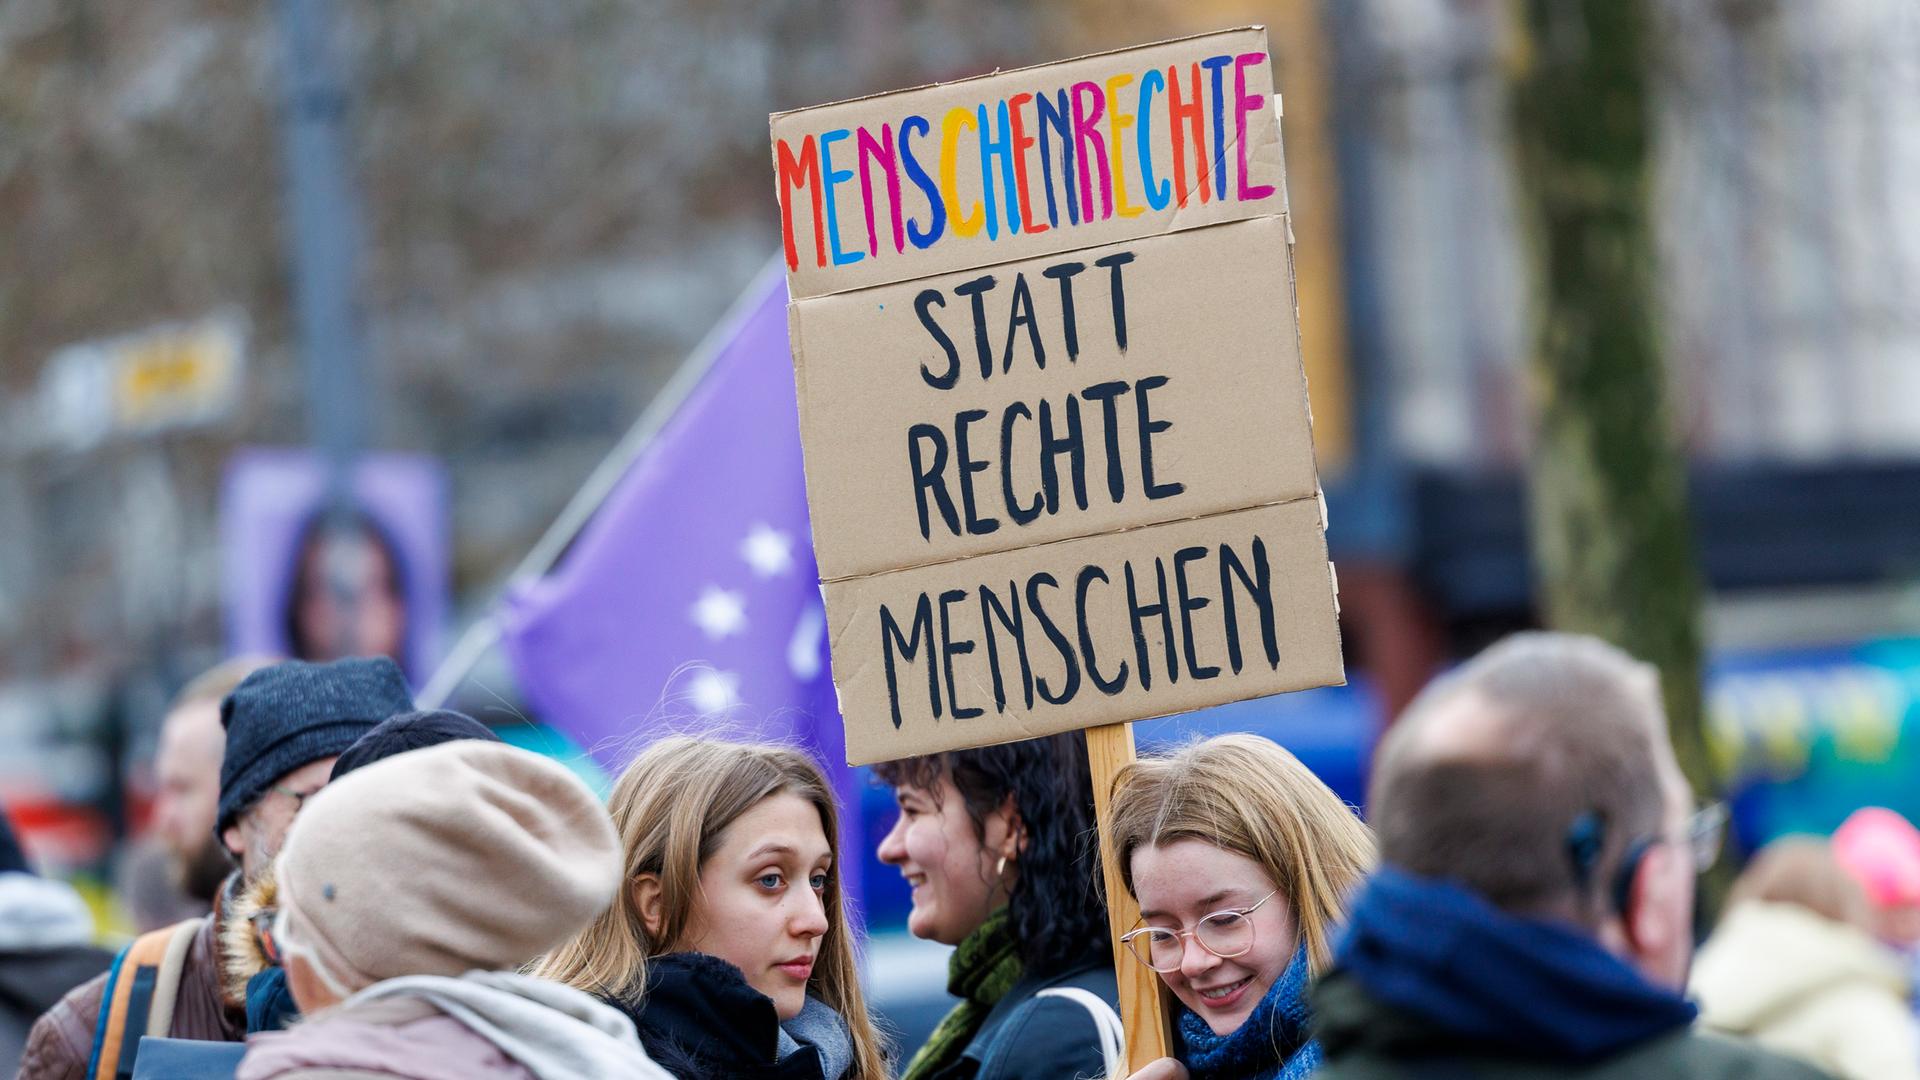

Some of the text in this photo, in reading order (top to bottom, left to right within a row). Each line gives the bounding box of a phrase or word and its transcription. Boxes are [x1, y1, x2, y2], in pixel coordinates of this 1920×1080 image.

[777, 52, 1275, 272] MENSCHENRECHTE
[914, 251, 1139, 390] STATT
[908, 376, 1186, 542] RECHTE
[880, 535, 1280, 730] MENSCHEN
